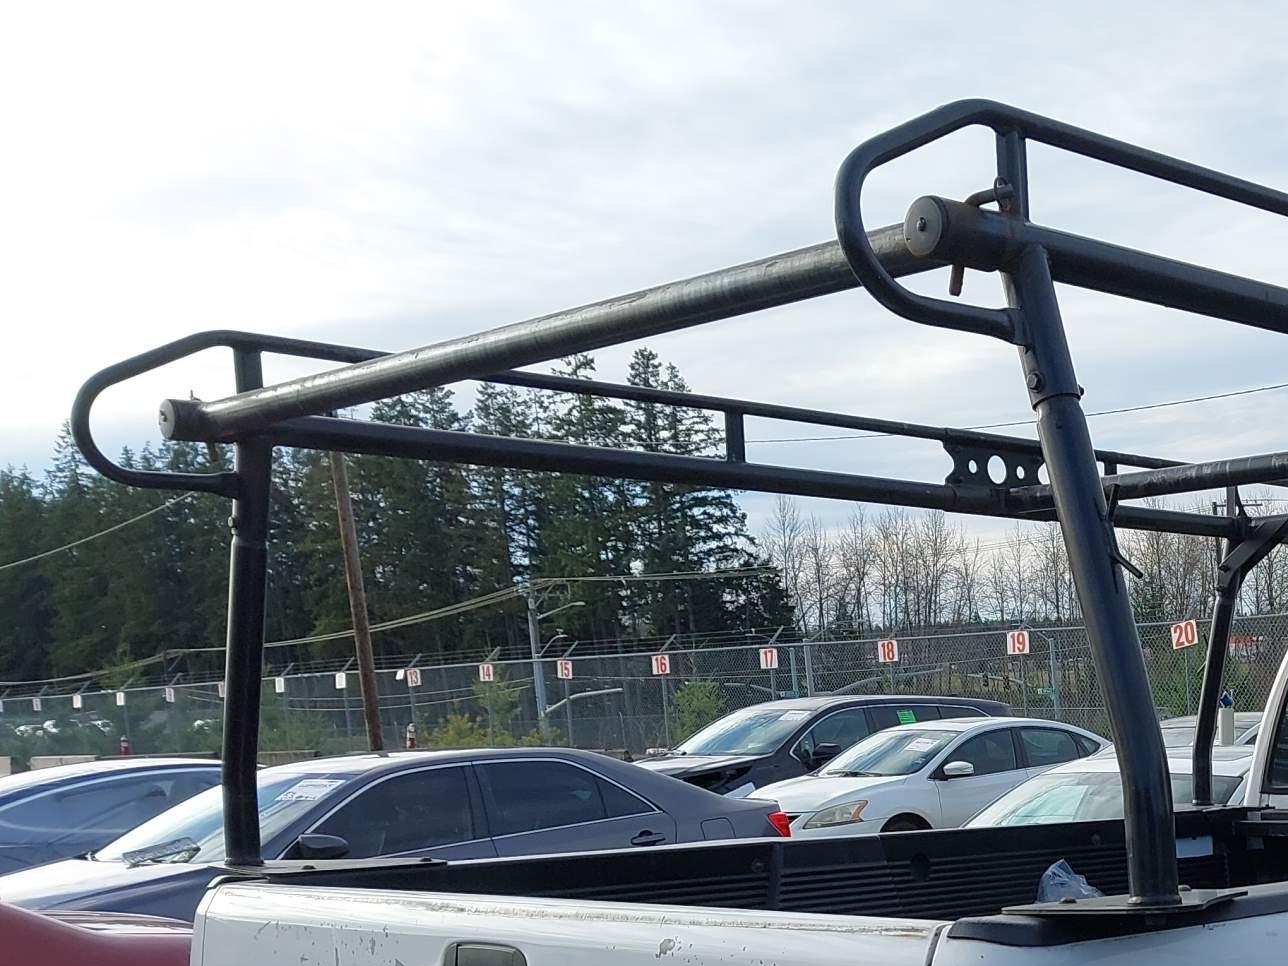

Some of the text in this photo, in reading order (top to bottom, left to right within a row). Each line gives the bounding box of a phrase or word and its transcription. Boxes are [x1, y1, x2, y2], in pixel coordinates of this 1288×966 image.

[1009, 632, 1027, 653] 19
[1174, 623, 1197, 649] 20
[763, 649, 774, 668] 17
[881, 641, 895, 661] 18
[481, 664, 492, 681] 14
[559, 660, 570, 678] 15
[655, 655, 667, 674] 16
[408, 670, 418, 685] 13
